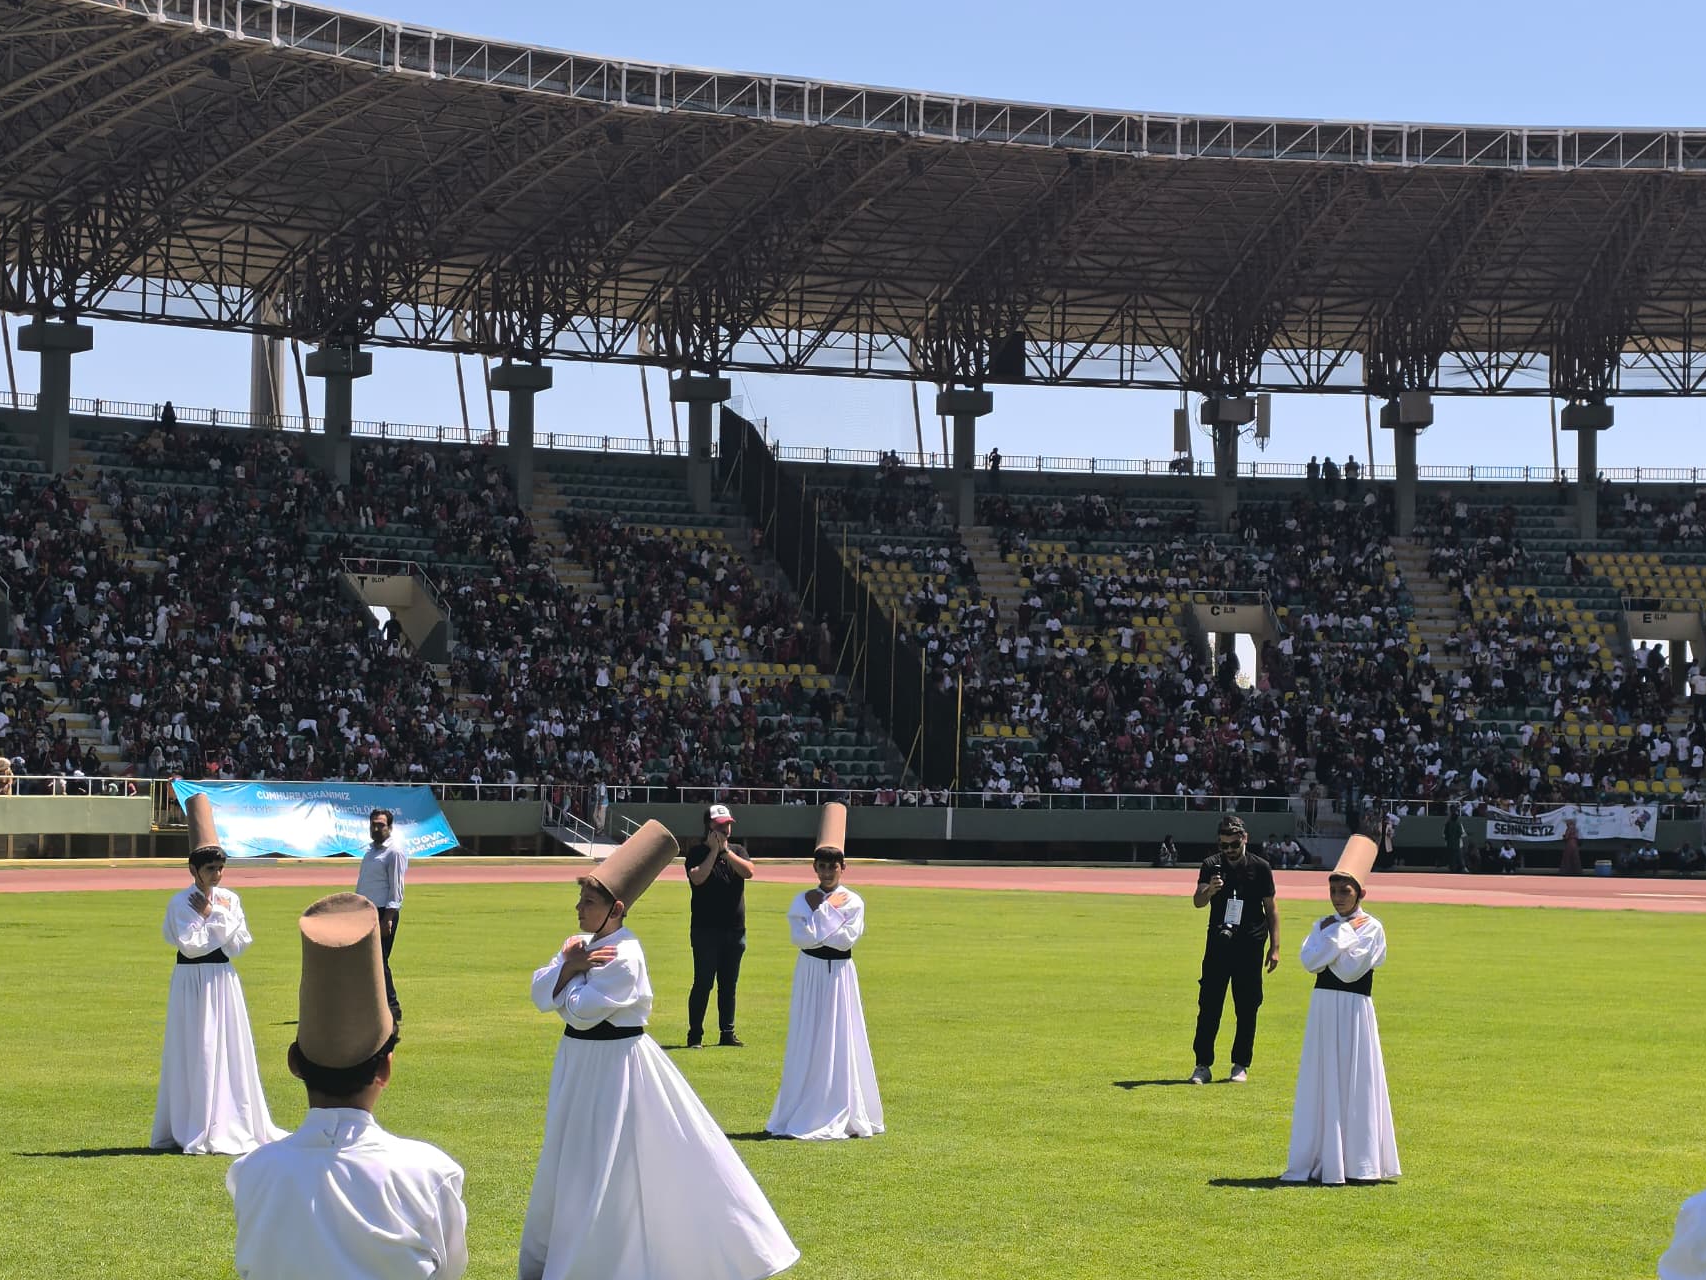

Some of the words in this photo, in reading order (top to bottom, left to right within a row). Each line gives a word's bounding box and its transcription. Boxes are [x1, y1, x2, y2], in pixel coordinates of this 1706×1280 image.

[357, 576, 367, 588] T
[1210, 605, 1220, 616] C
[1643, 613, 1652, 623] E
